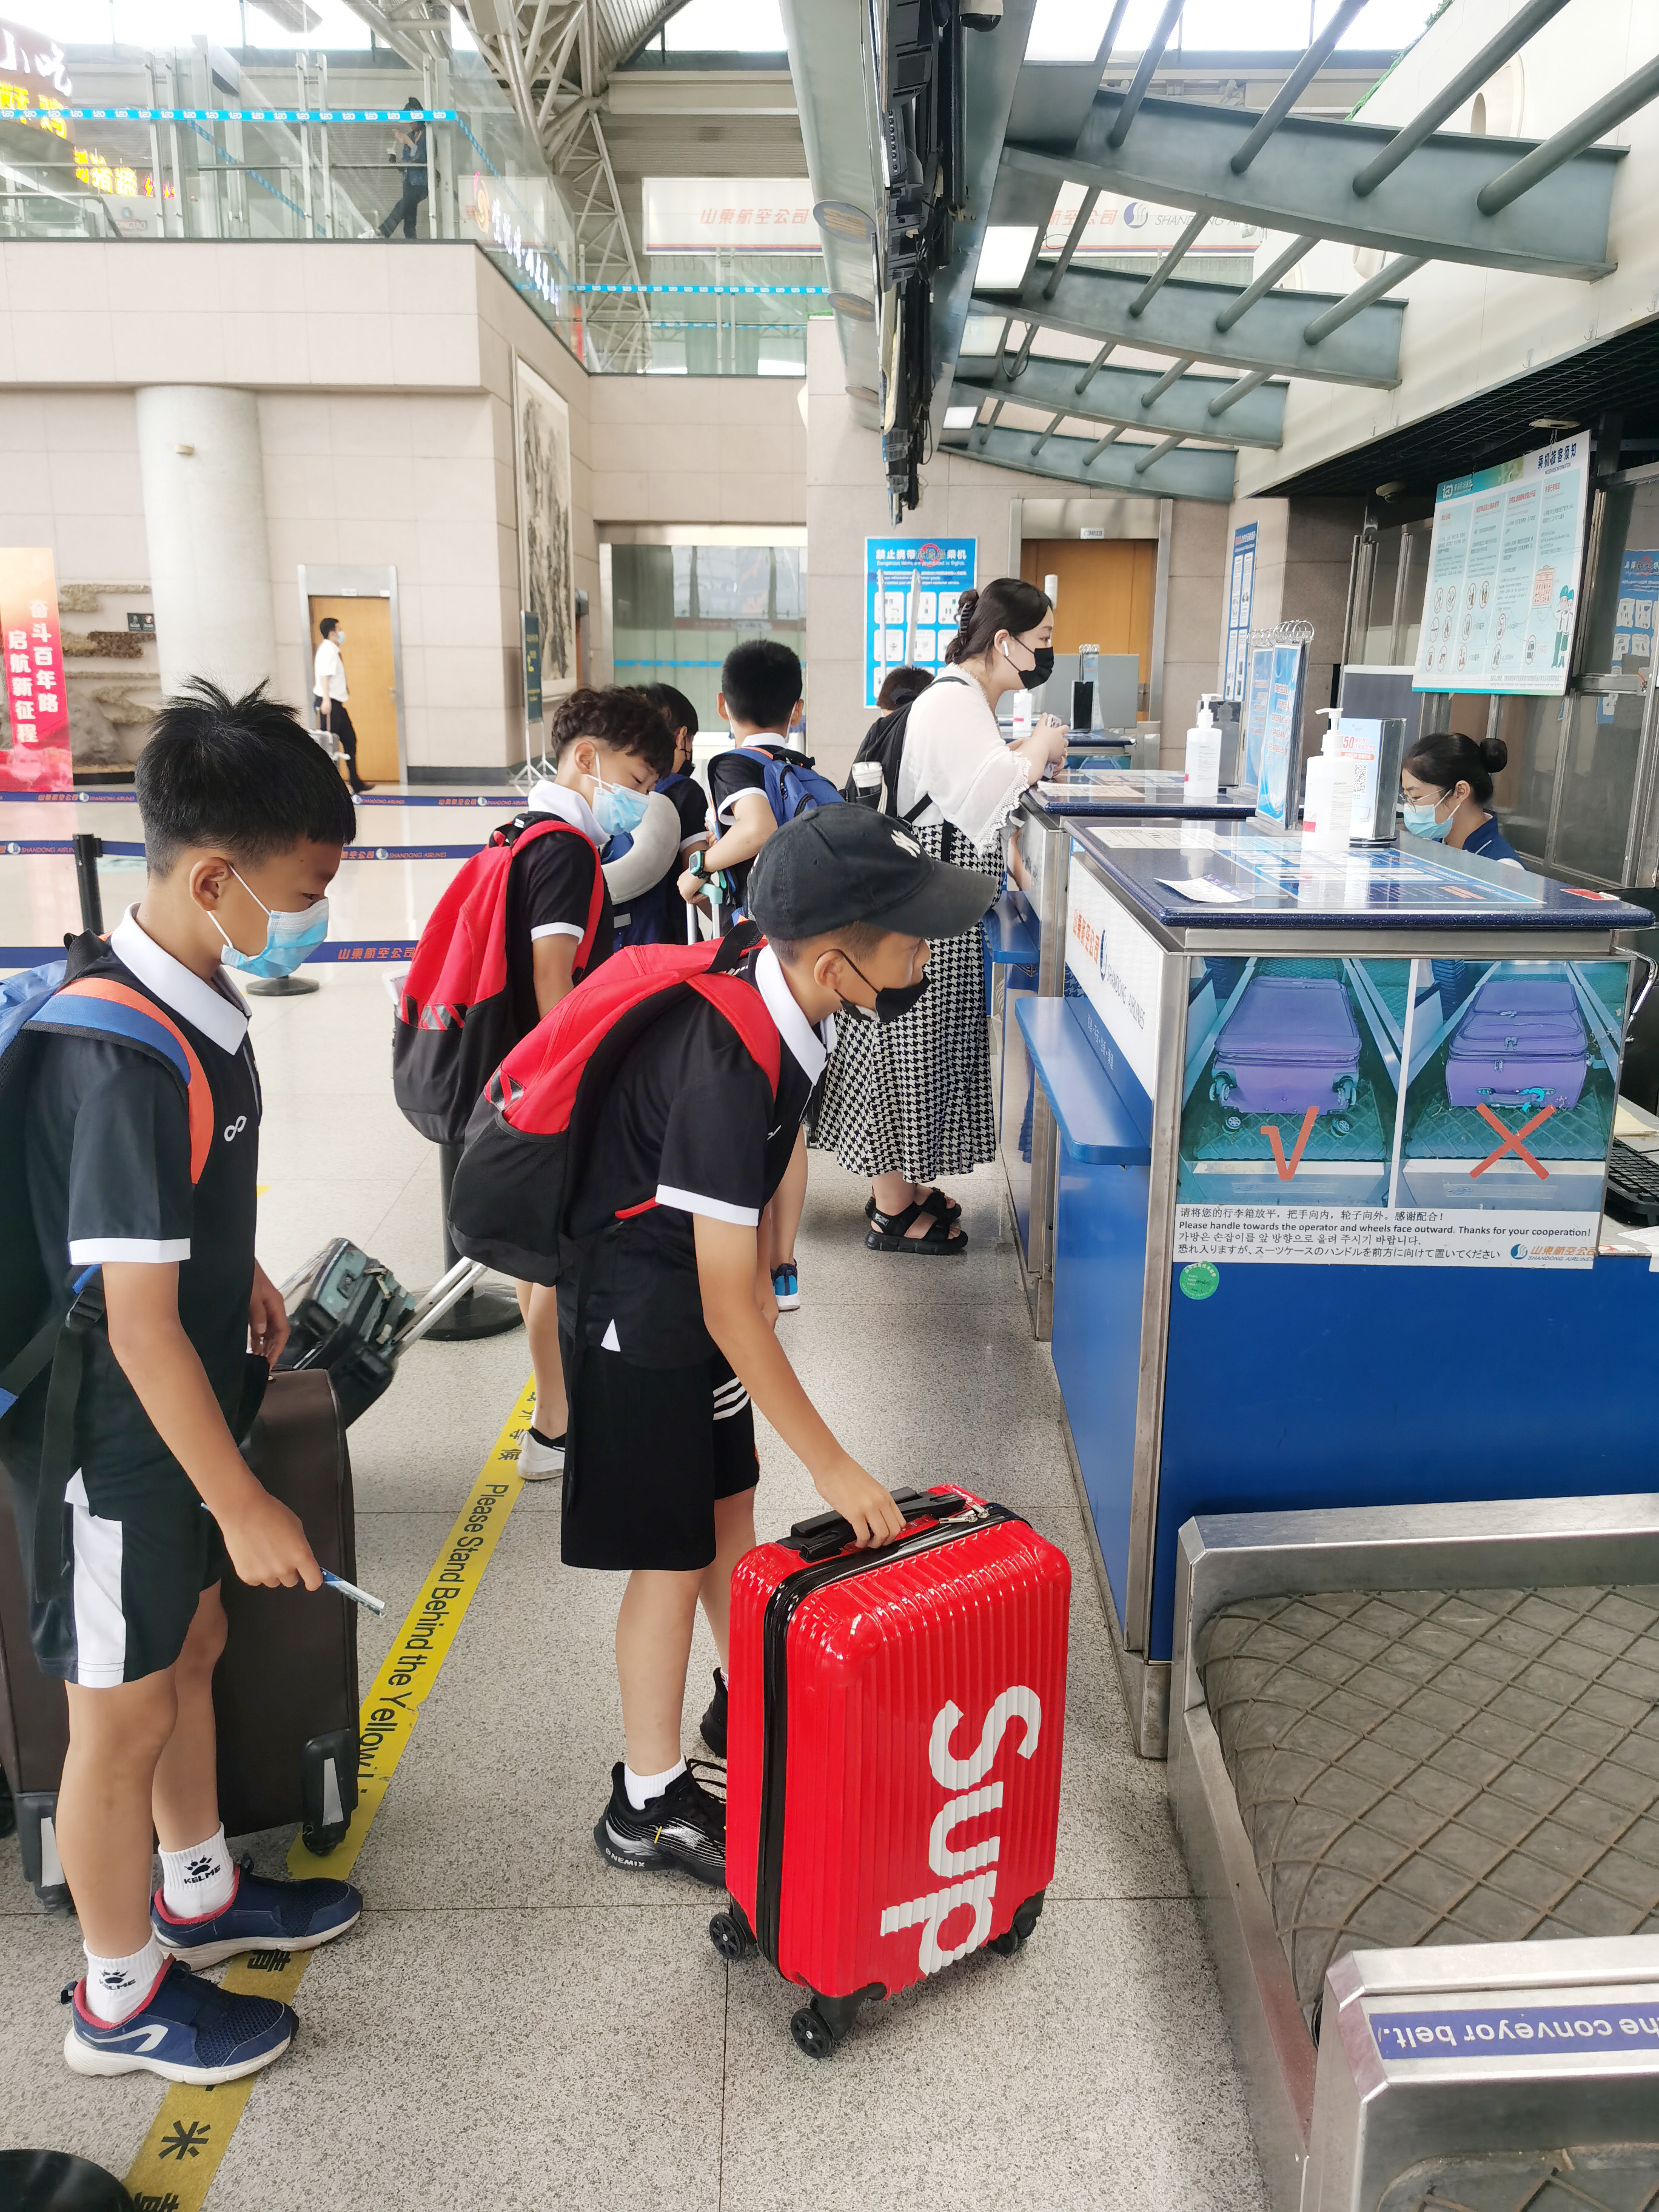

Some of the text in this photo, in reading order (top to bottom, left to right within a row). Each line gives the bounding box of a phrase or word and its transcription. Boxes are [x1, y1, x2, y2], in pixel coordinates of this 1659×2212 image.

[30, 599, 59, 712] 奋斗百年路
[8, 629, 39, 743] 启航新征程
[337, 947, 416, 960] 山東航空公司
[1179, 1221, 1208, 1230] Please
[1210, 1221, 1241, 1230] handle
[1243, 1222, 1279, 1230] towards
[1282, 1222, 1296, 1230] the
[1299, 1224, 1338, 1233] operator
[1340, 1223, 1357, 1232] and
[1359, 1224, 1391, 1232] wheels
[1393, 1224, 1412, 1233] face
[1458, 1226, 1490, 1235] Thanks
[1532, 1228, 1591, 1238] cooperation!
[1179, 1232, 1421, 1247] 가방은 손잡이를 앞 방향으로 올려 주시기 바랍니다.
[1178, 1244, 1501, 1259] 恐れ入りますが、スーツケースのハンドルを前方に向けて置いてください
[1530, 1245, 1597, 1256] 山東航空公司
[463, 1483, 509, 1533] Please
[440, 1534, 484, 1583] Stand
[404, 1587, 460, 1650] Behind
[388, 1654, 426, 1686] the
[880, 1685, 1041, 1976] Sup
[184, 1864, 221, 1884] KELME
[1382, 2017, 1659, 2049] he conveyor belt.
